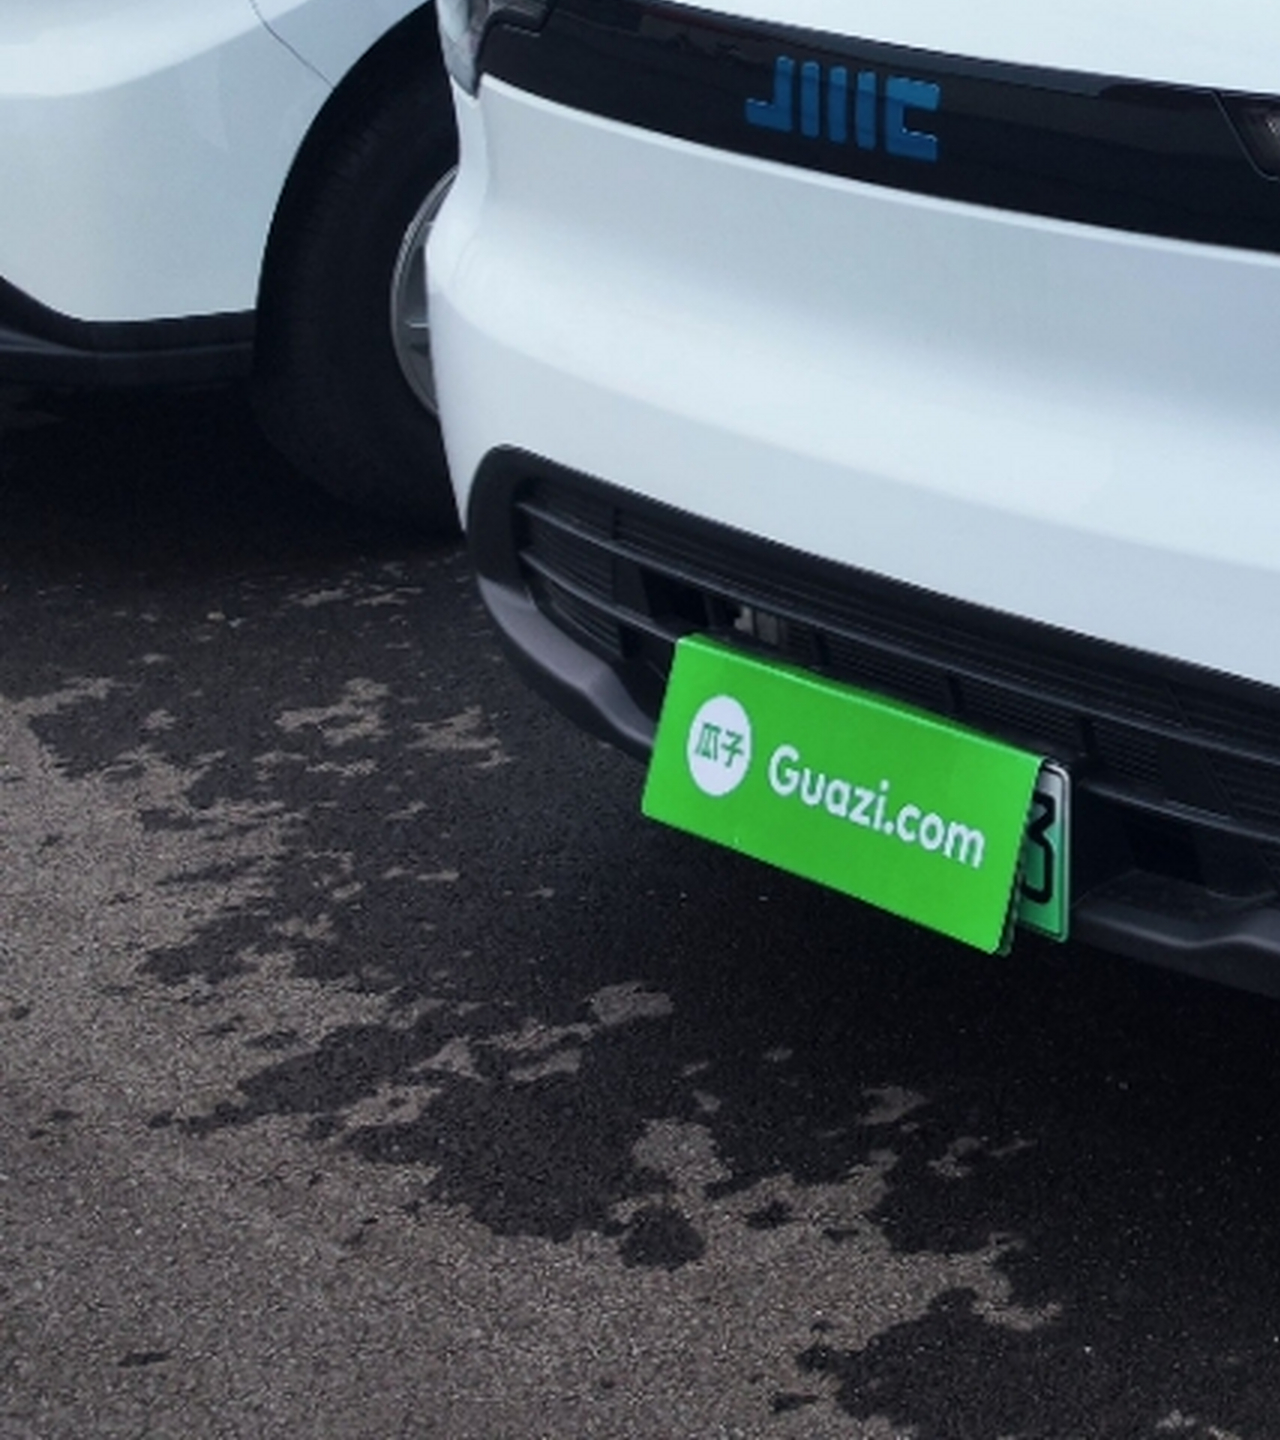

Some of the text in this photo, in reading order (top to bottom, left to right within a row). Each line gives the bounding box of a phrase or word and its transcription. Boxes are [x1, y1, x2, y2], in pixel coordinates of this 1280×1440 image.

[744, 56, 940, 162] JMC
[694, 722, 745, 768] 瓜子
[767, 744, 986, 869] Guazi.com
